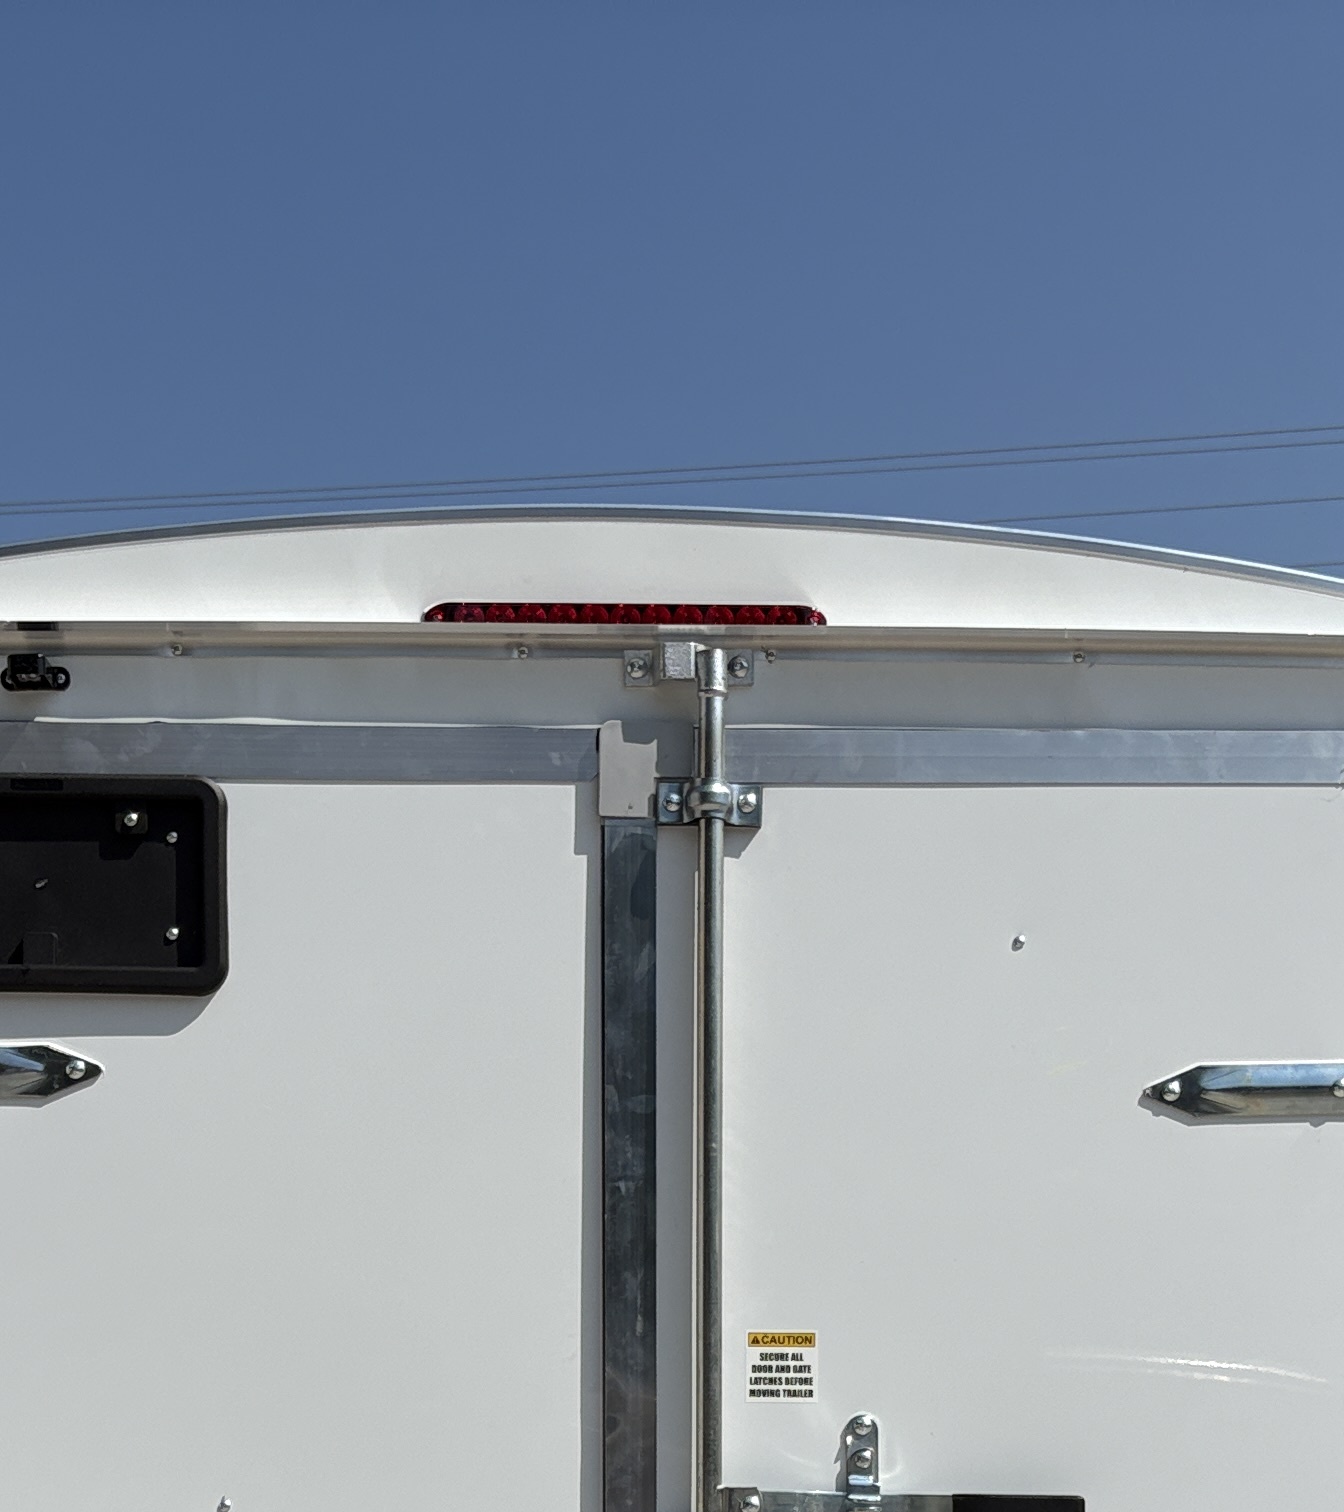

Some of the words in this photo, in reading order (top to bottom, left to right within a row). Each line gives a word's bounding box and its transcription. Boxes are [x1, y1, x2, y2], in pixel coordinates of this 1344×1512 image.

[761, 1335, 813, 1345] CAUTION
[759, 1352, 789, 1362] SECURE
[791, 1352, 804, 1362] ALL
[751, 1364, 773, 1374] DOOR
[775, 1364, 791, 1374] AND
[792, 1364, 812, 1374] GATE
[749, 1376, 783, 1386] LATCHES
[784, 1376, 814, 1386] BEFORE
[748, 1388, 780, 1398] MOVING
[782, 1388, 814, 1398] TRAILER
